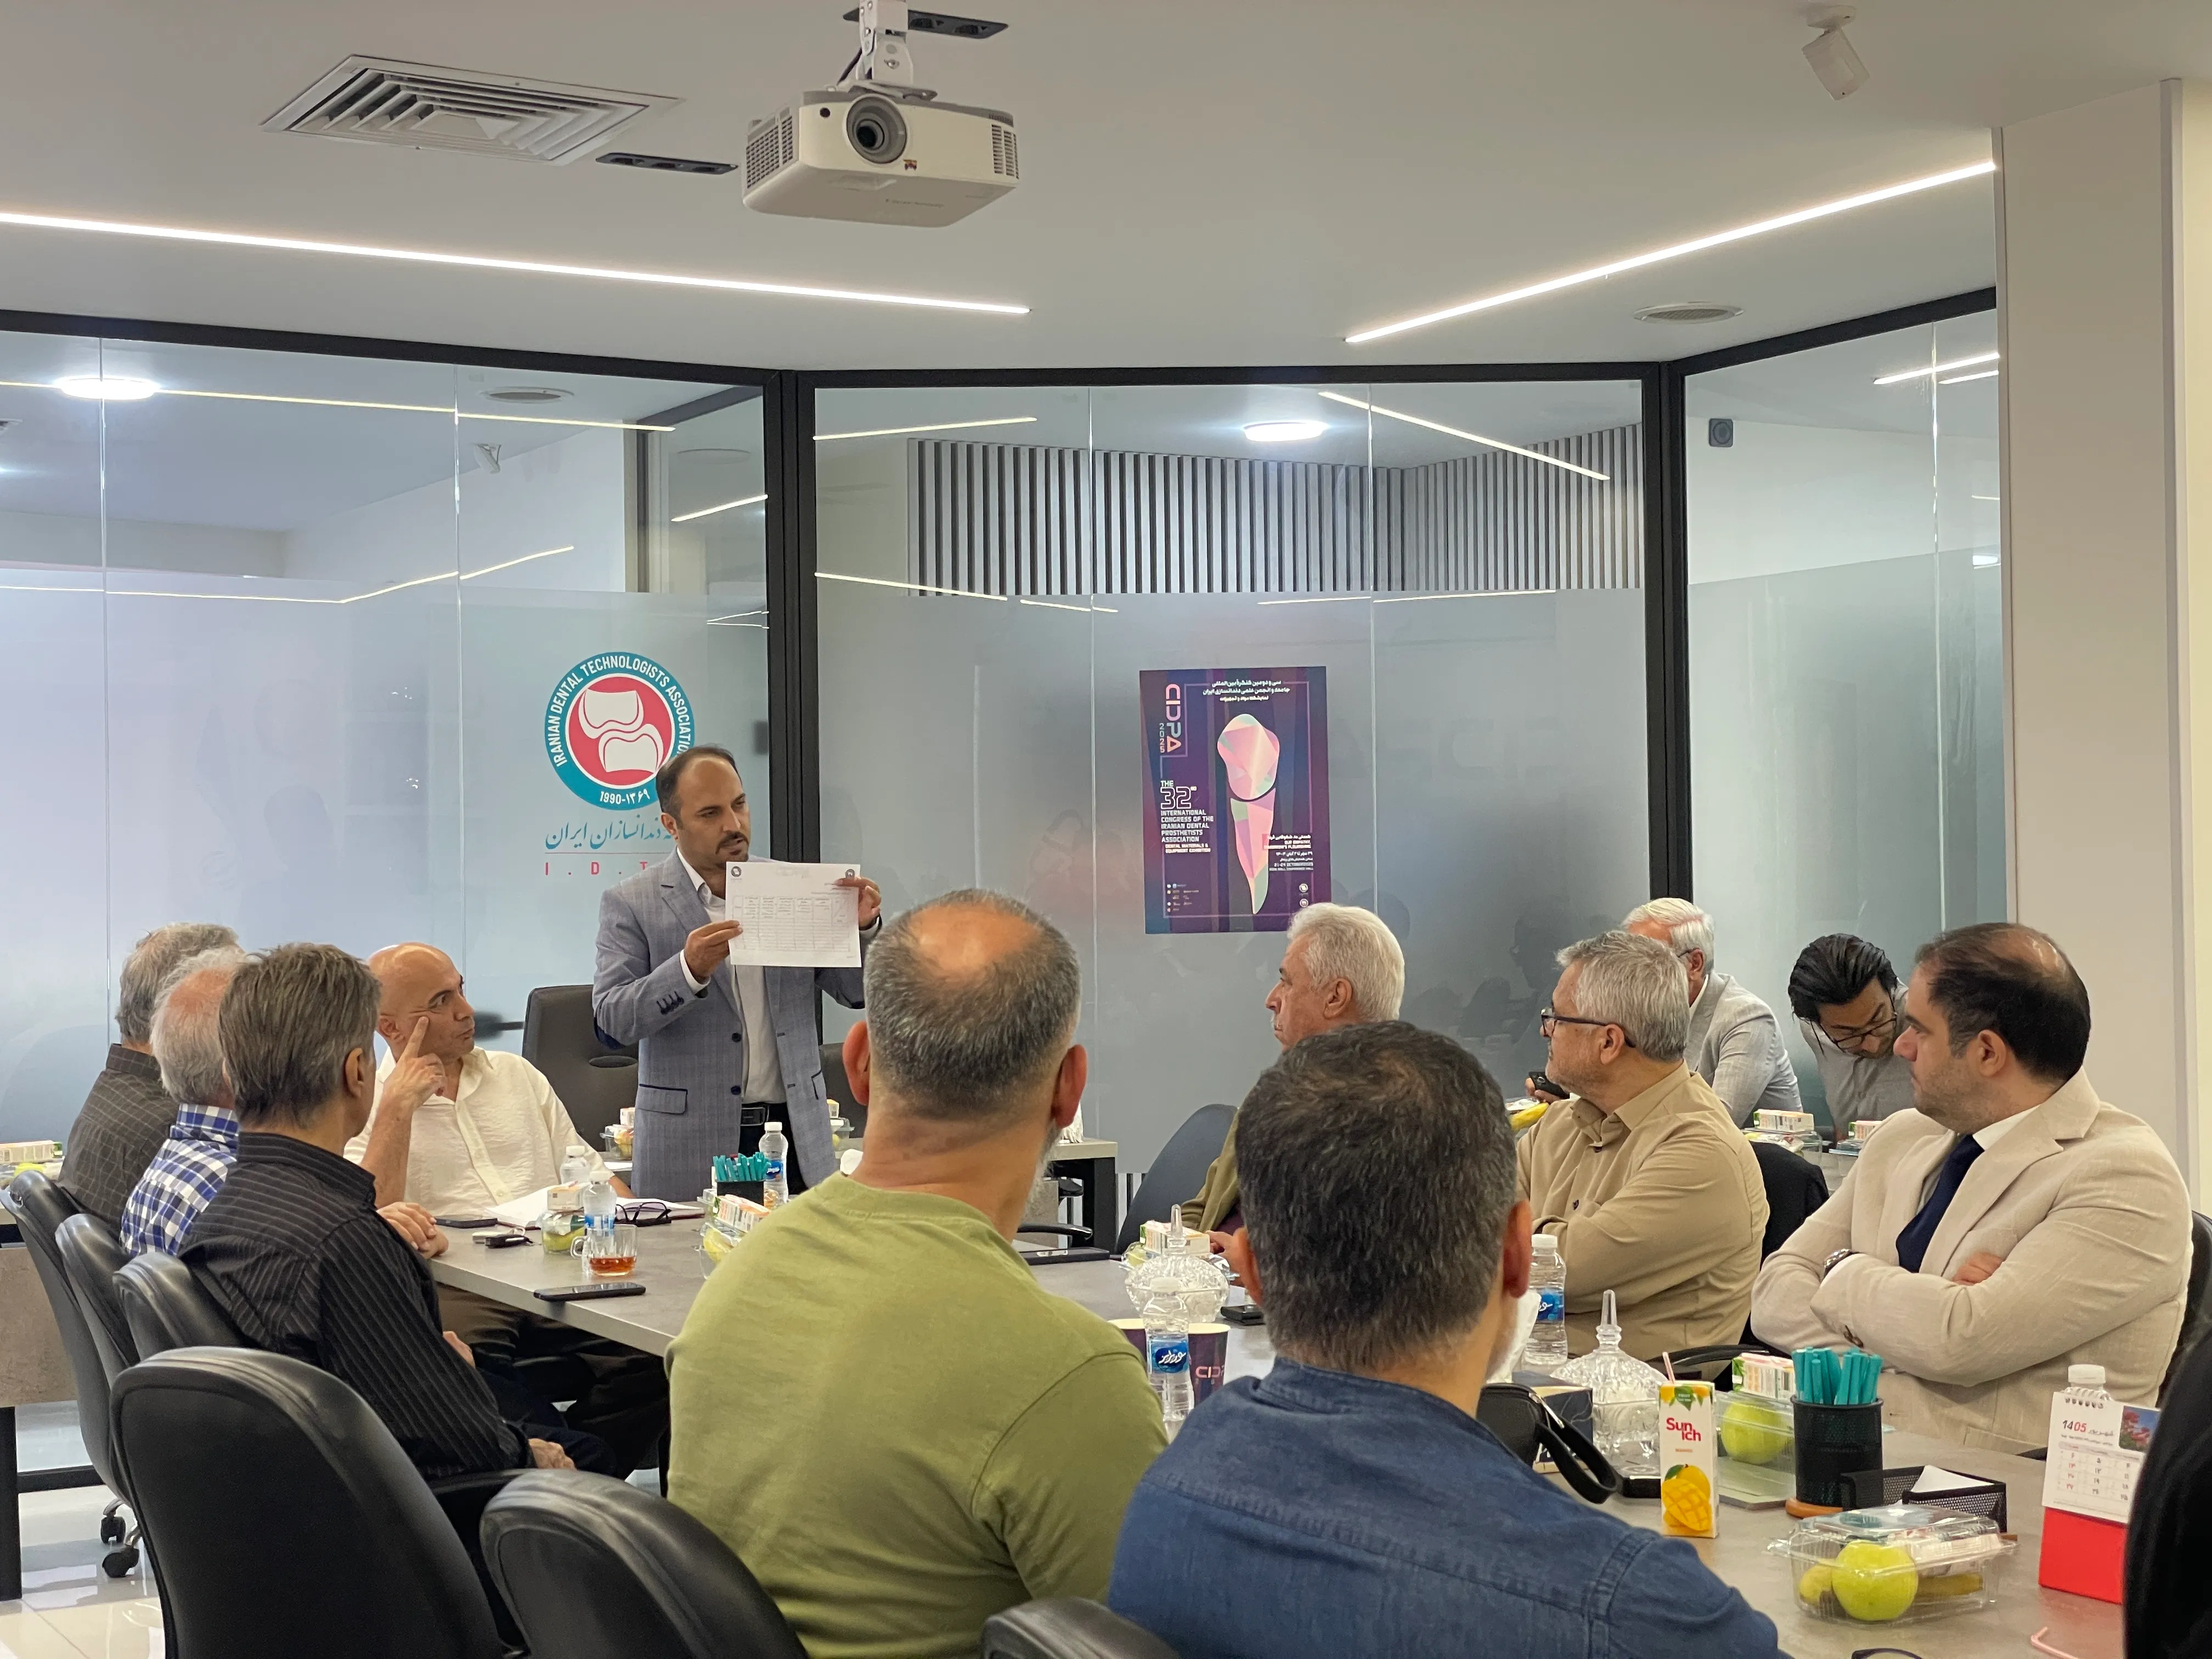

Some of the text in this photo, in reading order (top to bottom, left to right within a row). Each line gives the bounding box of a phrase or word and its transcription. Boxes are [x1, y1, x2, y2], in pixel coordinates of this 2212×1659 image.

[548, 656, 691, 767] IRANIAN DENTAL TECHNOLOGISTS ASSOCIATIO
[1166, 684, 1181, 753] CIDPA
[545, 822, 588, 849] ایران
[2063, 1420, 2087, 1432] 1405
